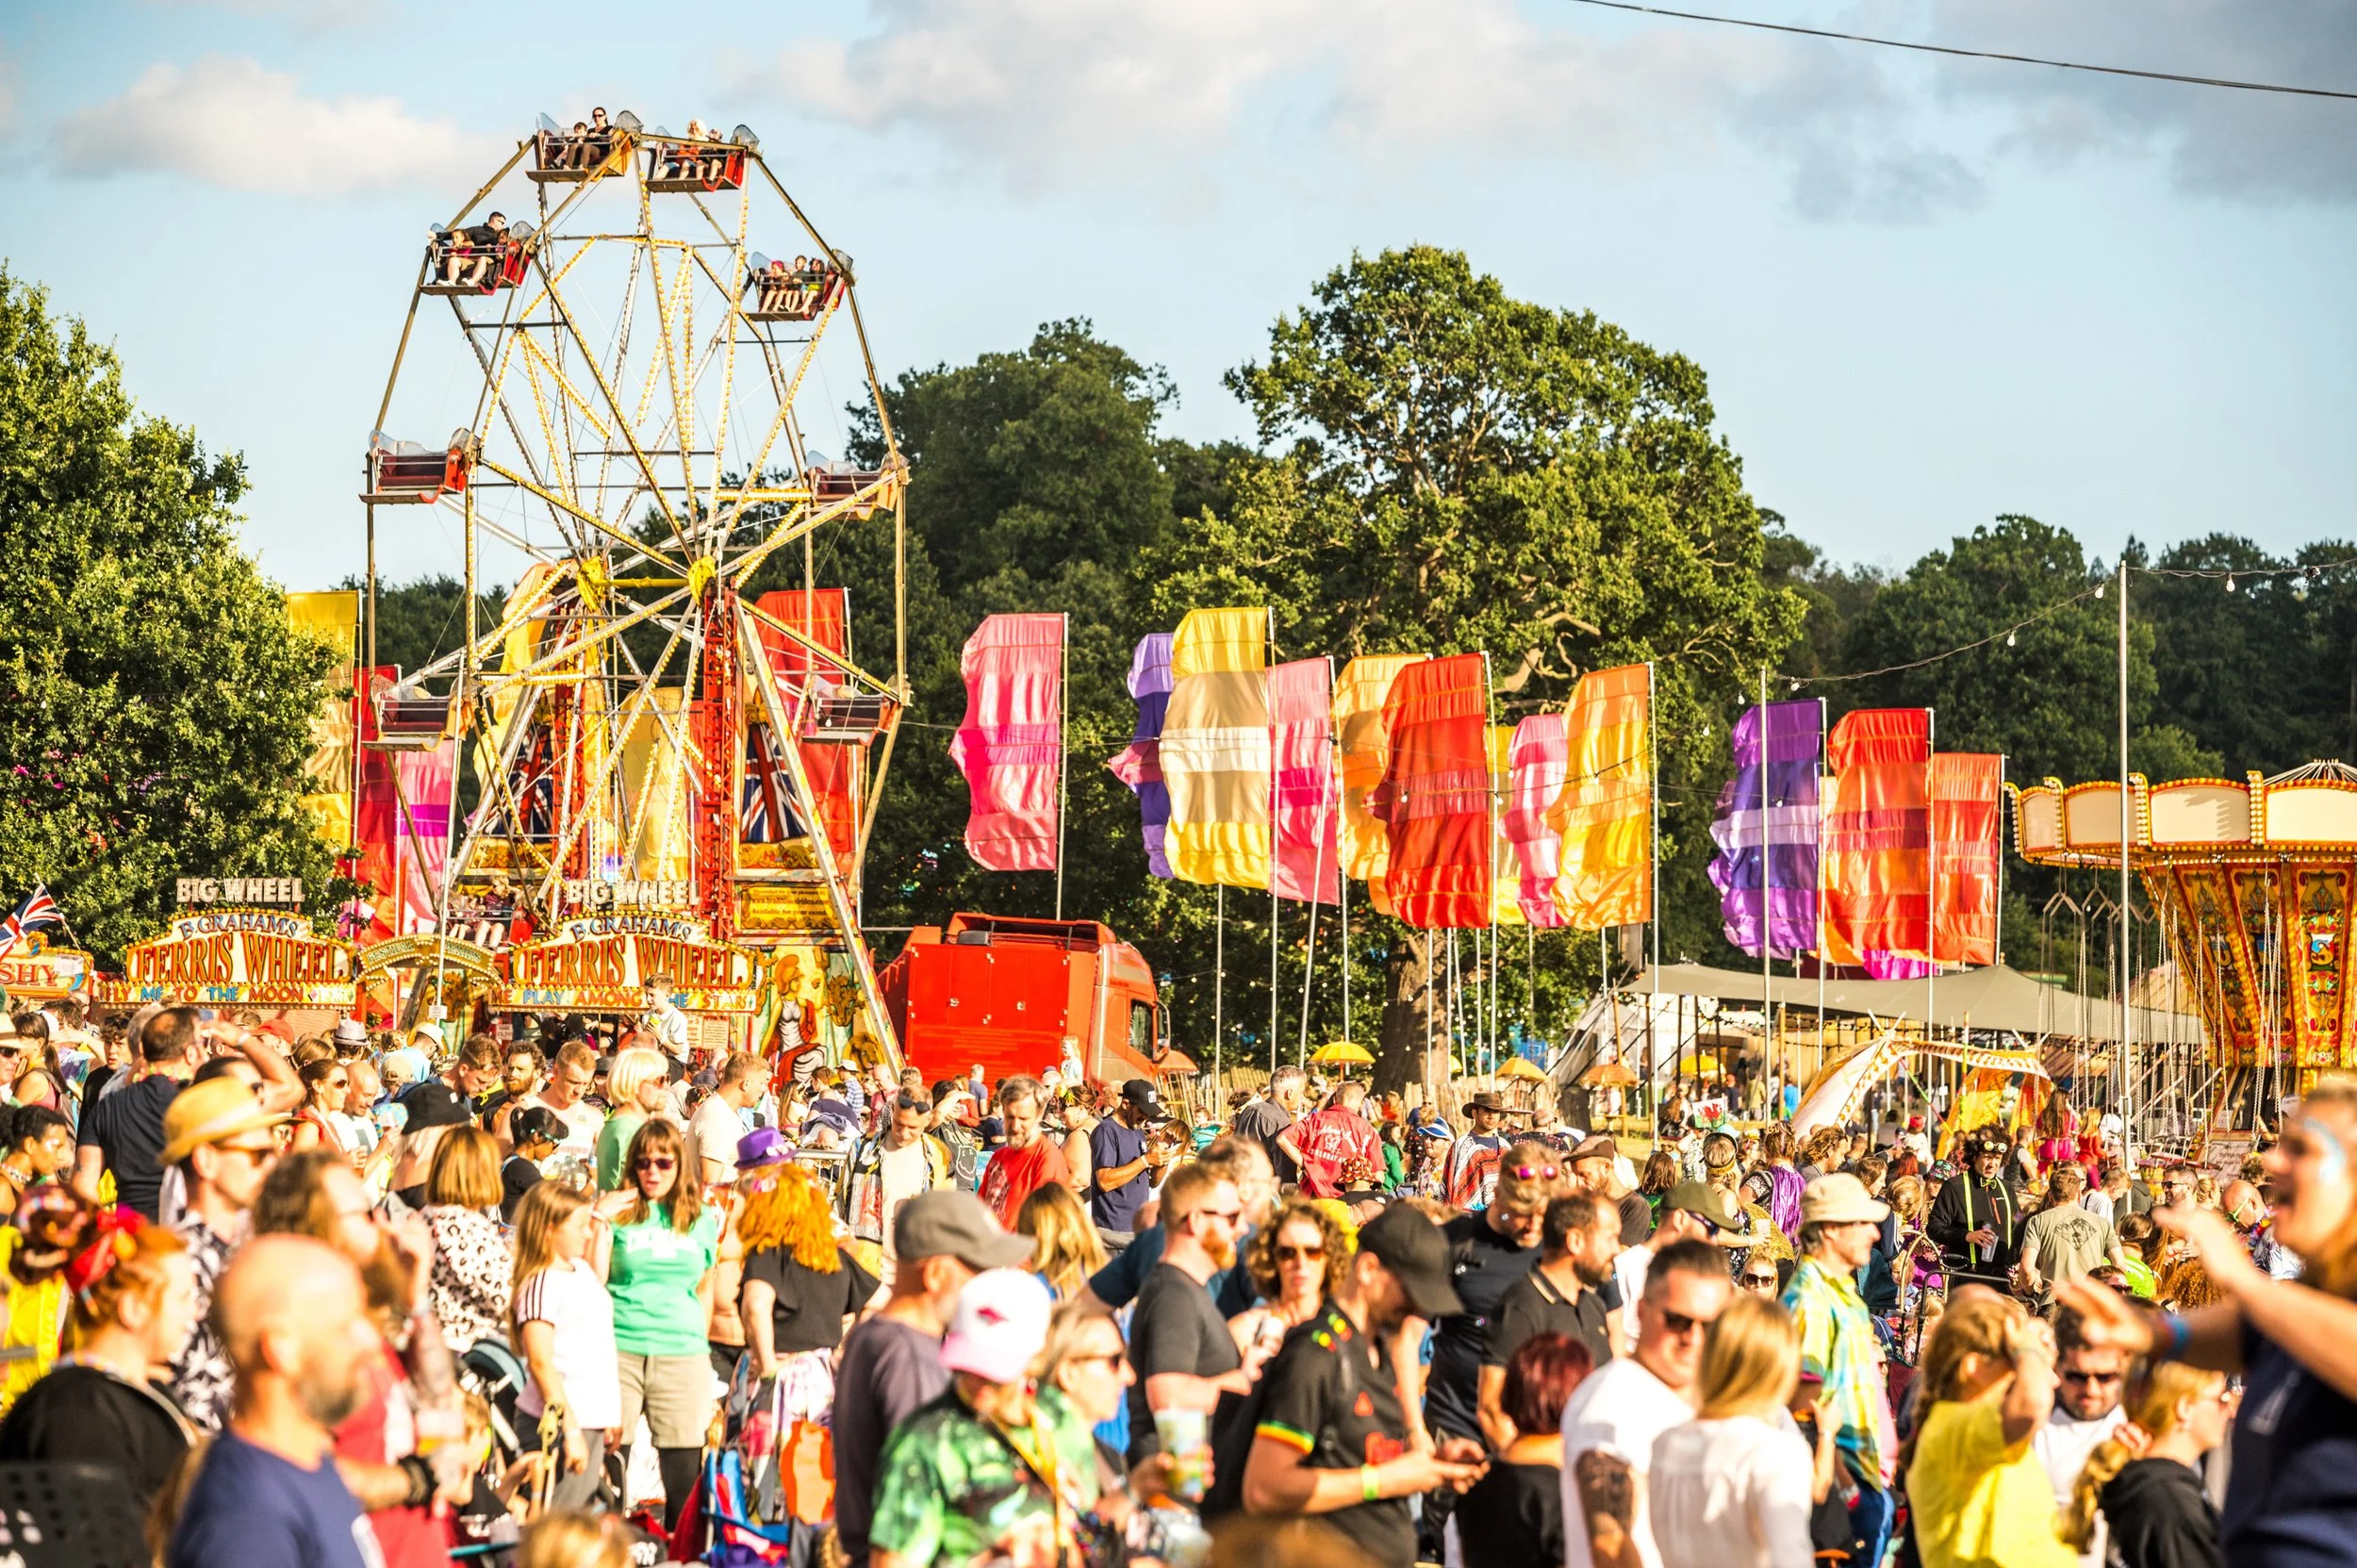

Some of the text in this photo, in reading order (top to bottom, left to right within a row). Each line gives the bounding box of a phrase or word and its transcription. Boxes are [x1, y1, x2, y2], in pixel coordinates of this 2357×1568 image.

[176, 877, 306, 903] BIG WHEEL
[568, 879, 701, 905] BIG WHEEL
[136, 932, 345, 982] FERRIS WHEEL
[524, 934, 742, 988] FERRIS WHEEL
[0, 963, 57, 986] SHY
[105, 984, 304, 1002] FLY ME TO THE MOON
[491, 989, 512, 1004] ME
[522, 989, 565, 1005] PLAY
[574, 989, 642, 1007] AMONG
[668, 993, 688, 1008] HE
